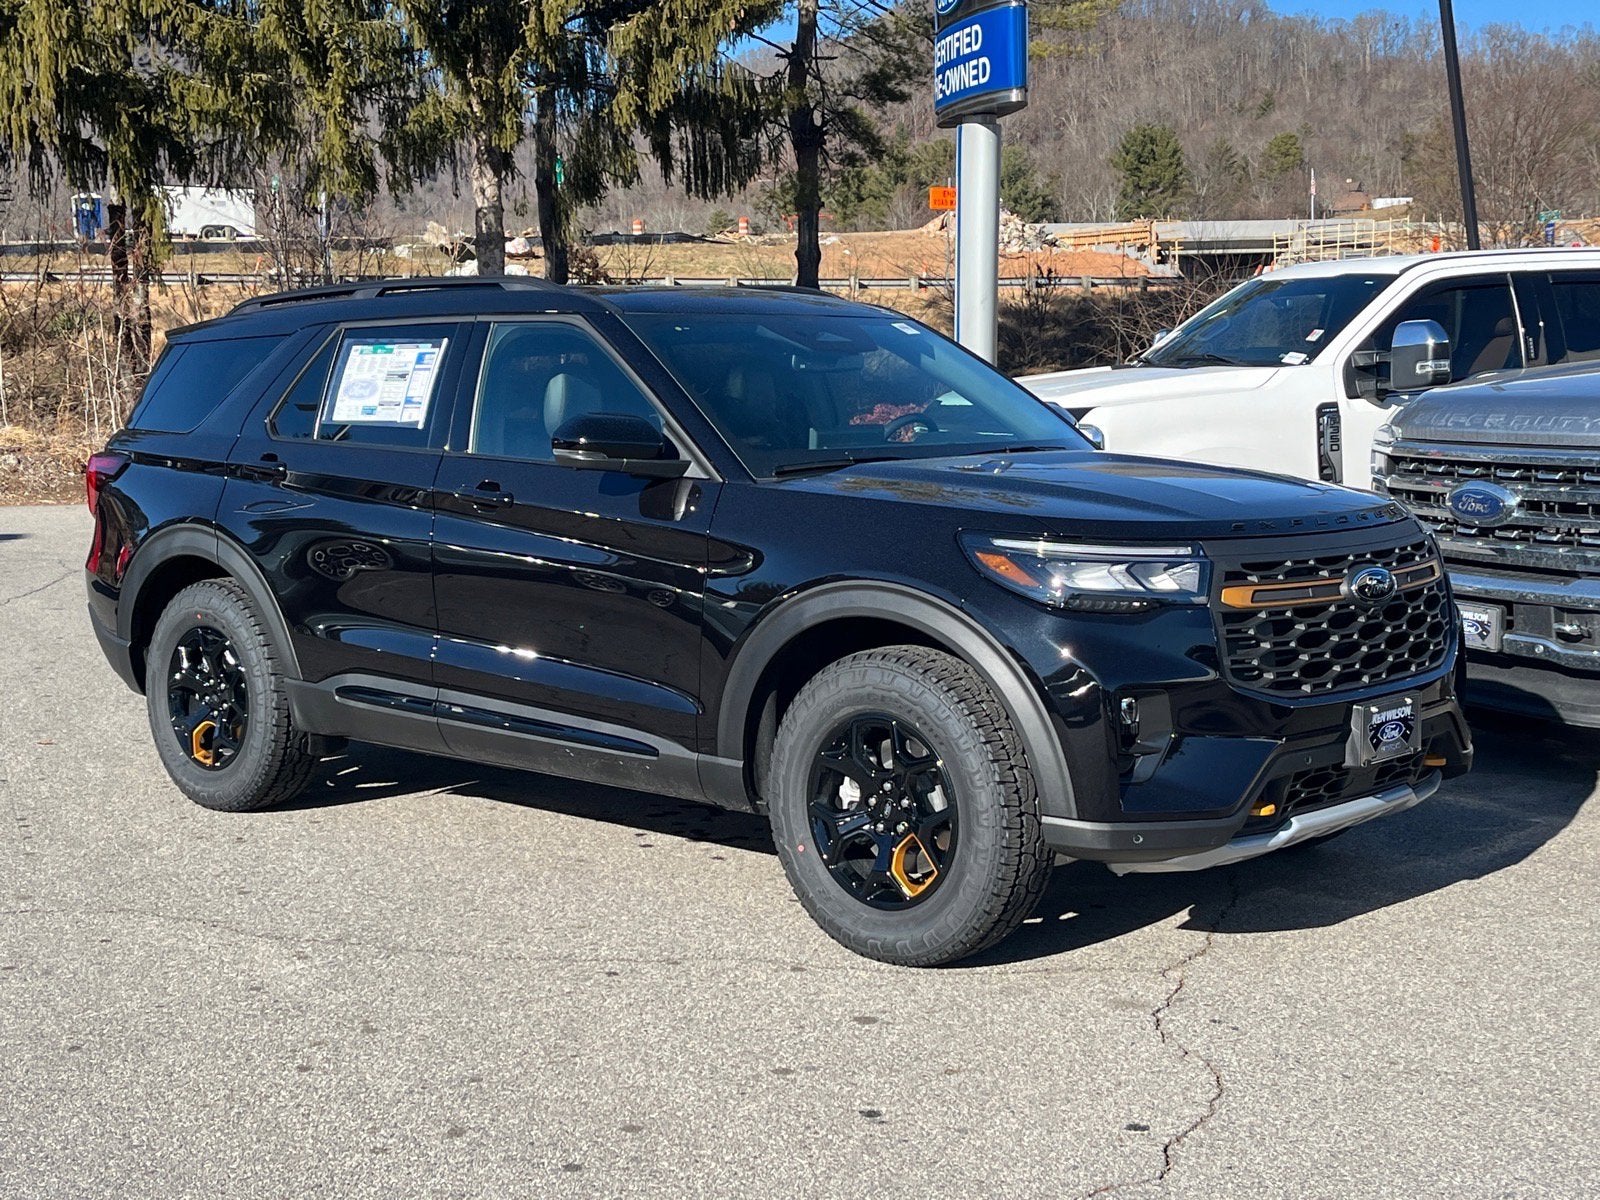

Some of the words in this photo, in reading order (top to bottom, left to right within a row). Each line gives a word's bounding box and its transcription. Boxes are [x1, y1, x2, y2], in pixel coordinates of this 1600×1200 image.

[935, 24, 982, 68] ERTIFIED
[1458, 494, 1492, 514] Ford
[1231, 506, 1399, 532] EXPLORER
[1382, 724, 1400, 740] Ford
